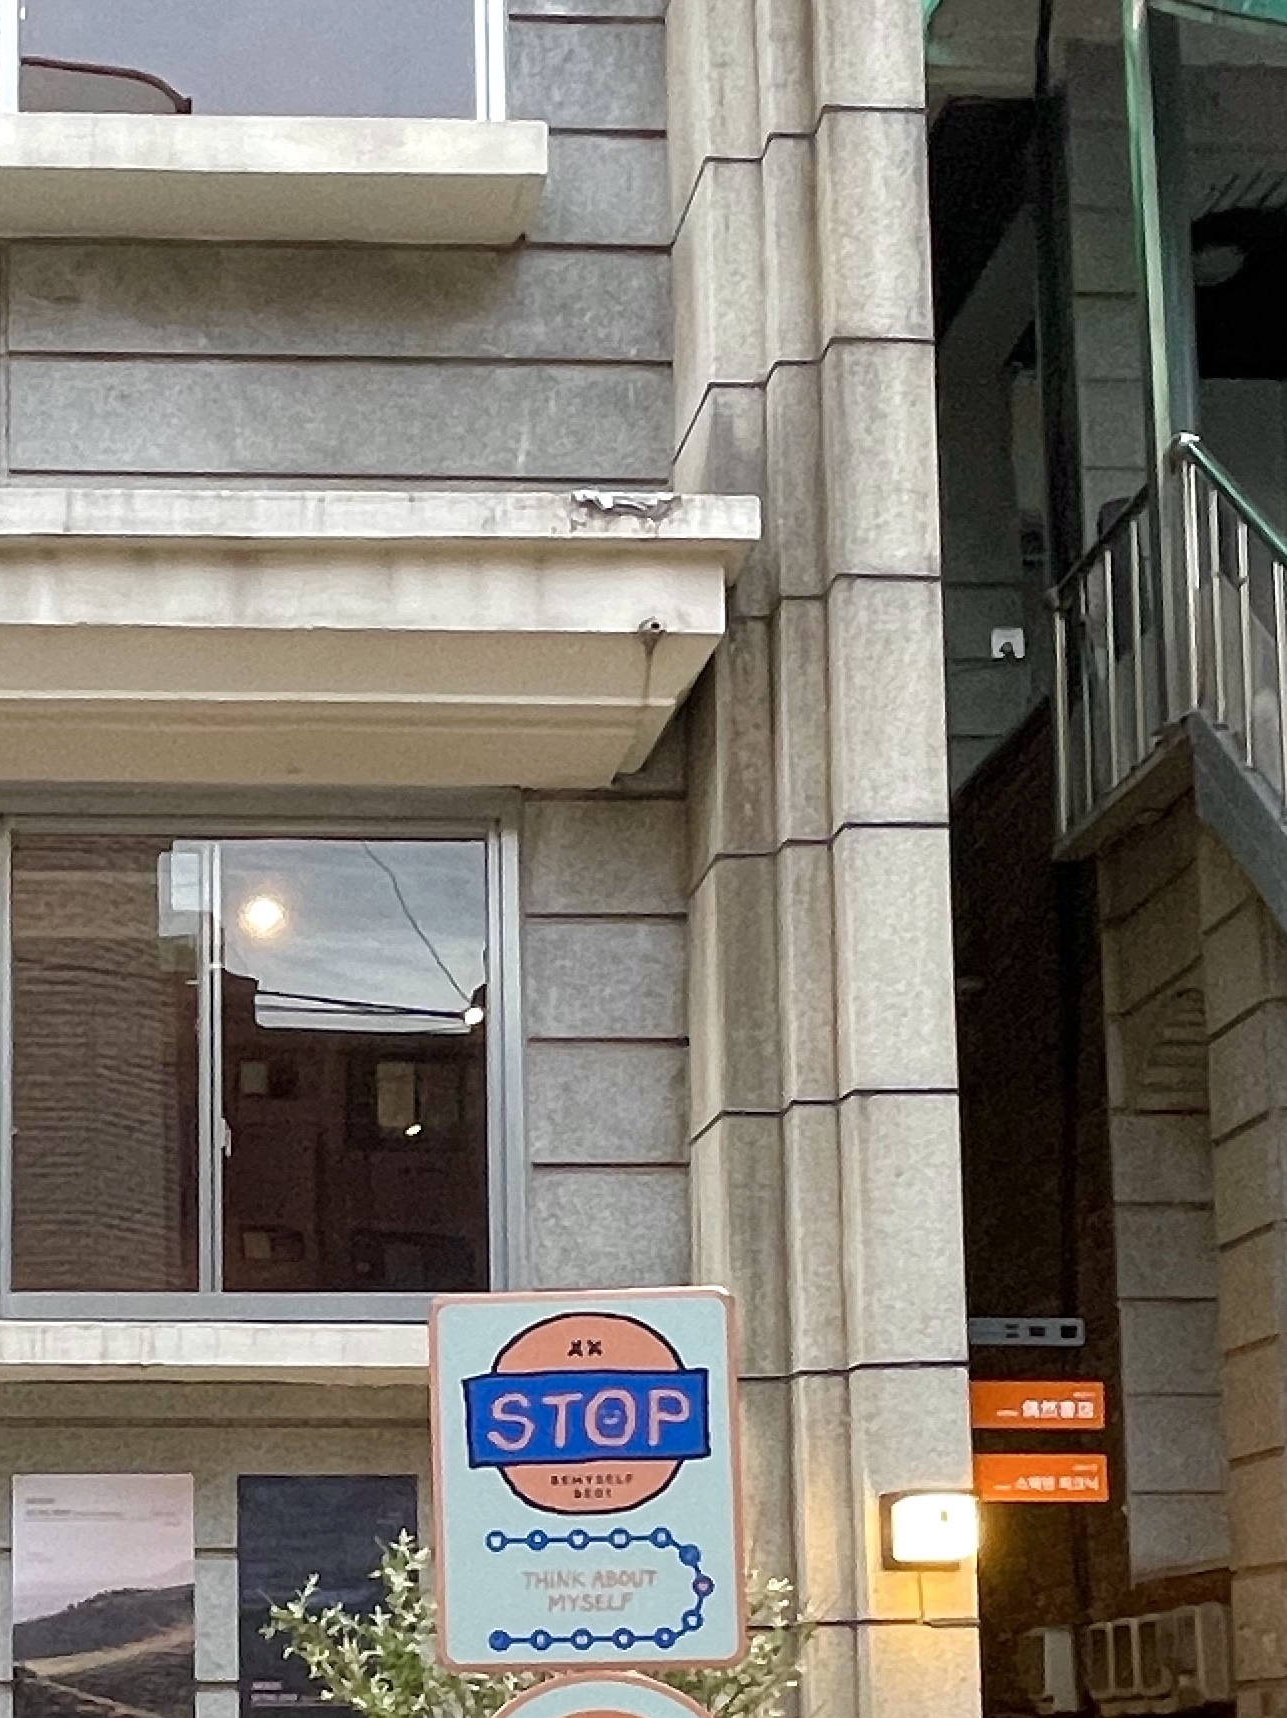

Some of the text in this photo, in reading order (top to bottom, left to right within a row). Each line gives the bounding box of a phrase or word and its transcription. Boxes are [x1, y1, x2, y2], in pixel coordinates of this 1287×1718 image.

[486, 1388, 691, 1451] STOP
[522, 1568, 658, 1590] THINK ABOUT
[547, 1592, 634, 1613] MYSELF
